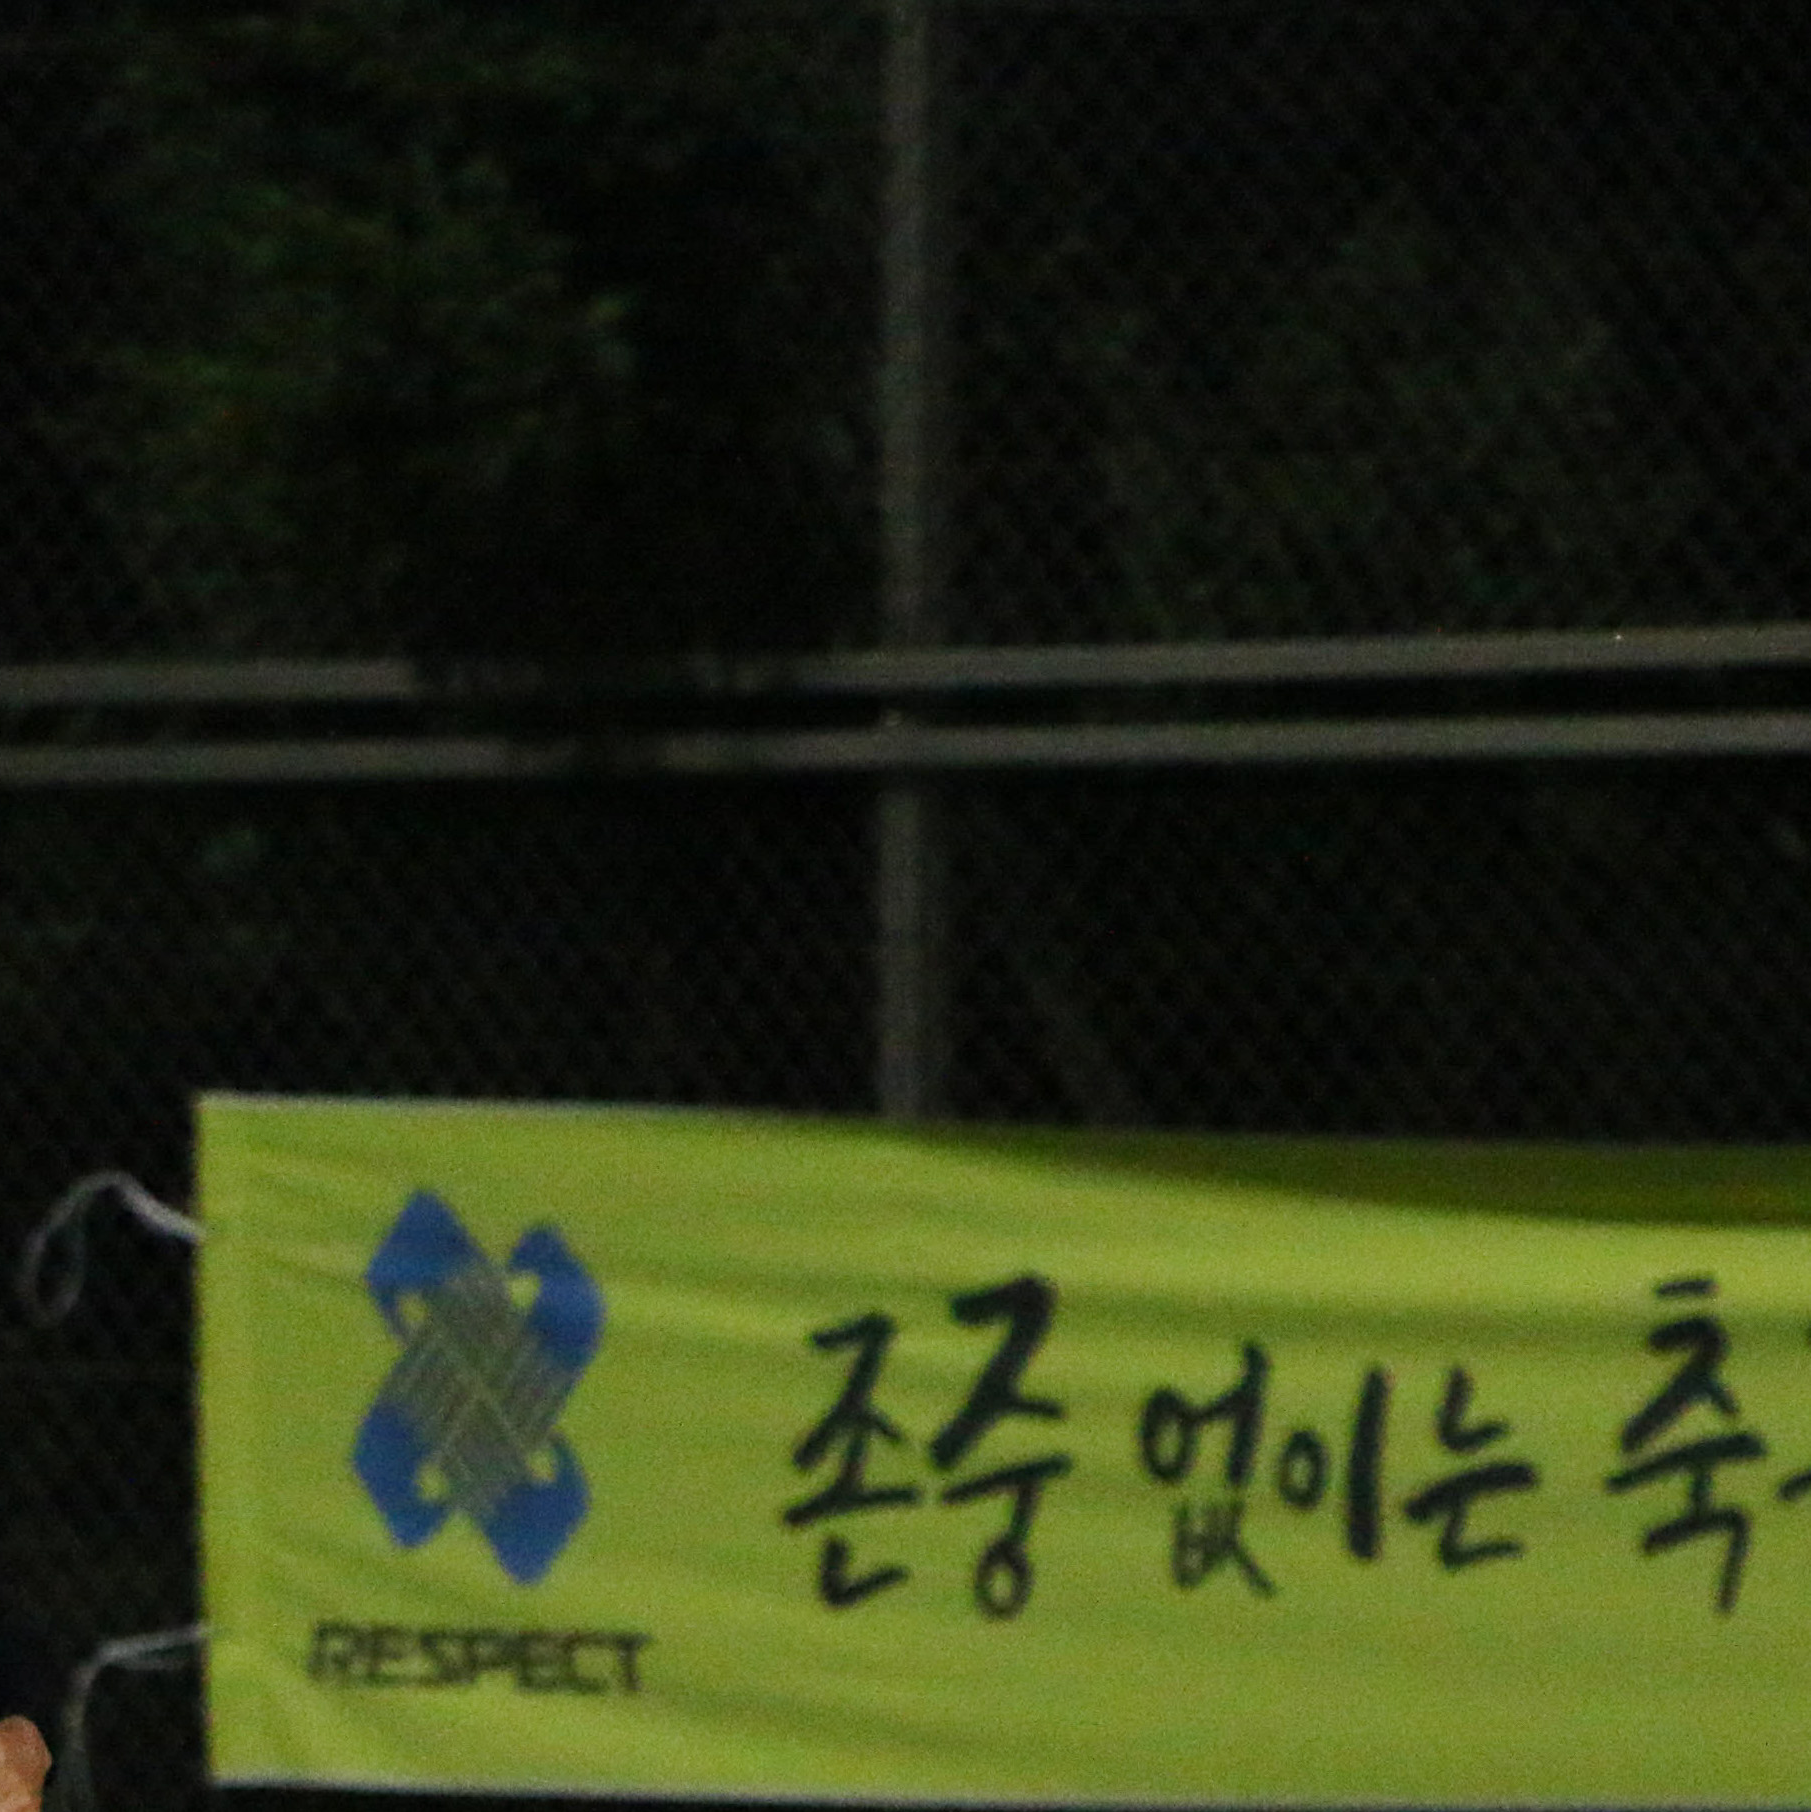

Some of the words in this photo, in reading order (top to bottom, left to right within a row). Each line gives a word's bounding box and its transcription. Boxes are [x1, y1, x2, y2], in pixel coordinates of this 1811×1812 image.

[783, 1272, 1072, 1618] 존중
[1138, 1338, 1540, 1597] 없이는
[1606, 1276, 1811, 1614] 축
[307, 1620, 653, 1692] RESPECT
